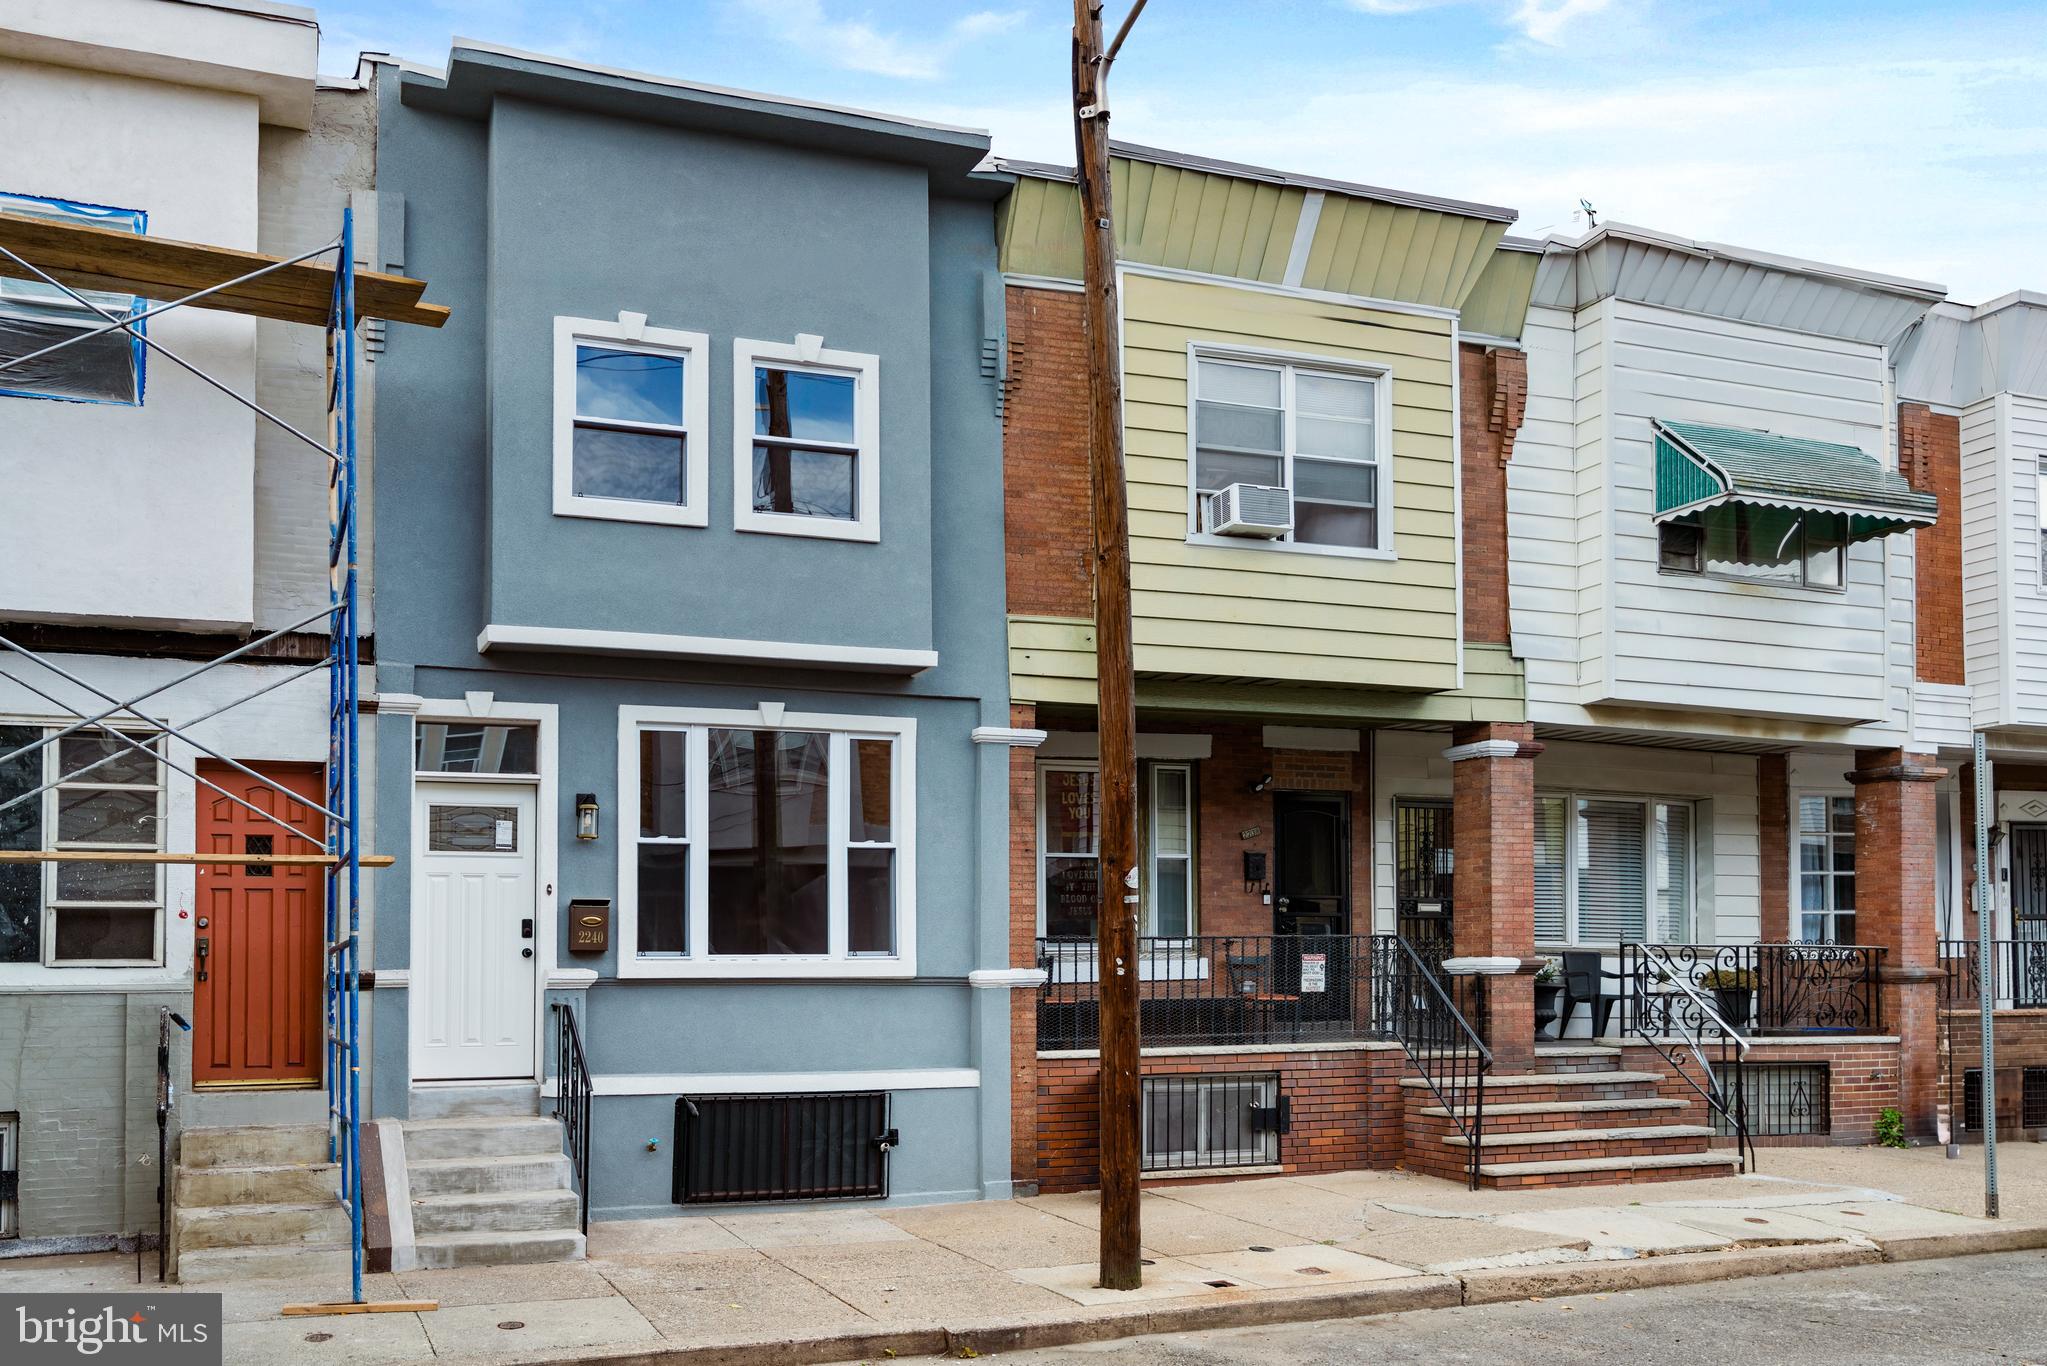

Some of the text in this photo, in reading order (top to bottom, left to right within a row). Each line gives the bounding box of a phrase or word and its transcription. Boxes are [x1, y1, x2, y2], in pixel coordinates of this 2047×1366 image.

[1062, 773, 1095, 786] JESUS
[1062, 791, 1096, 804] LOVES
[1068, 807, 1091, 819] YOU
[1060, 894, 1088, 903] BLOOD
[578, 931, 604, 944] 2240
